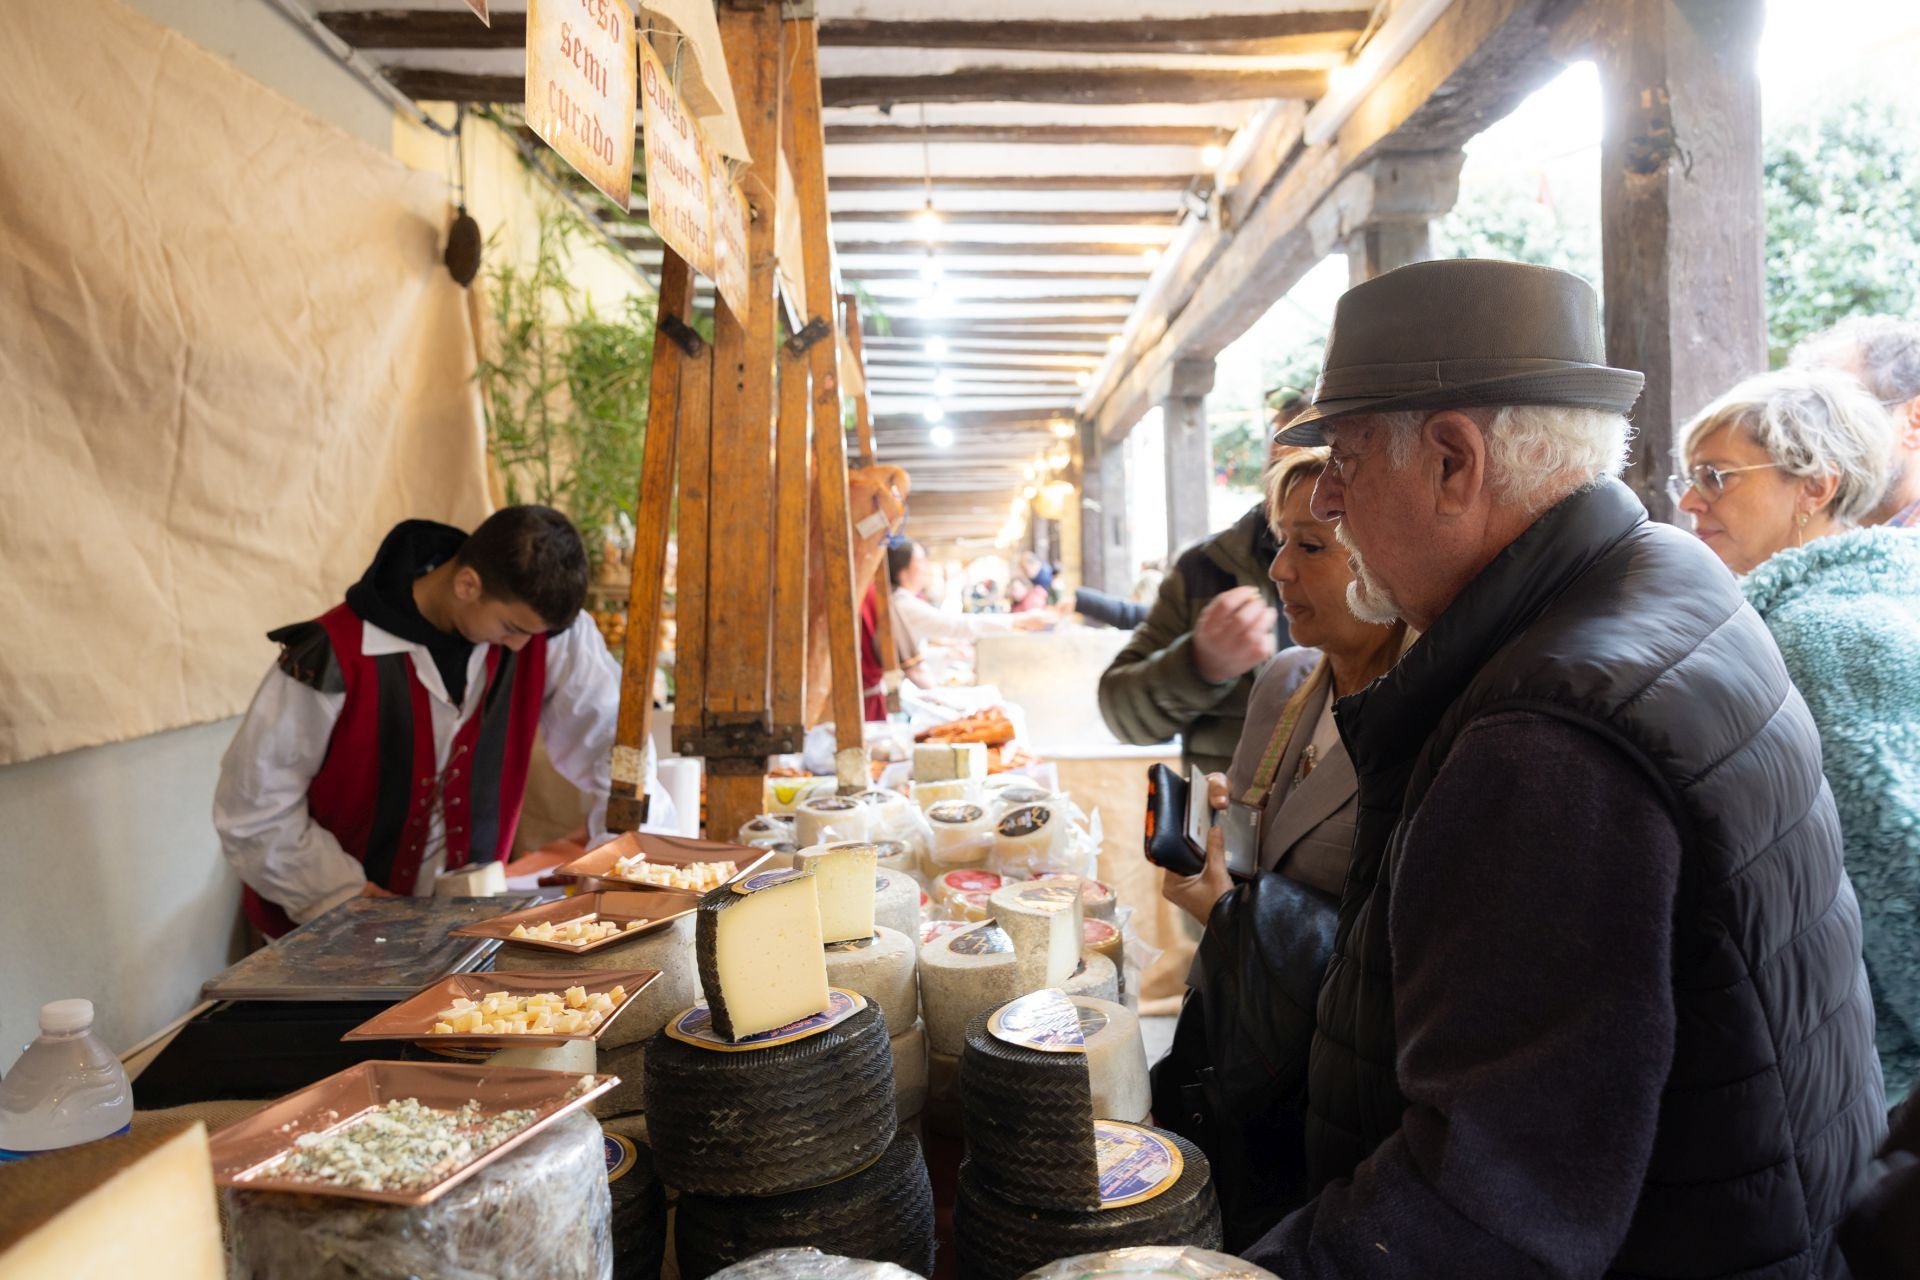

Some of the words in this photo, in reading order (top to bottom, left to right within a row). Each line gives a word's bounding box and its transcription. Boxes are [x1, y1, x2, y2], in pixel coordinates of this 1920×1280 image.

[560, 22, 608, 98] semi
[548, 79, 614, 166] curado
[643, 59, 688, 140] Queso
[674, 205, 709, 256] cabra
